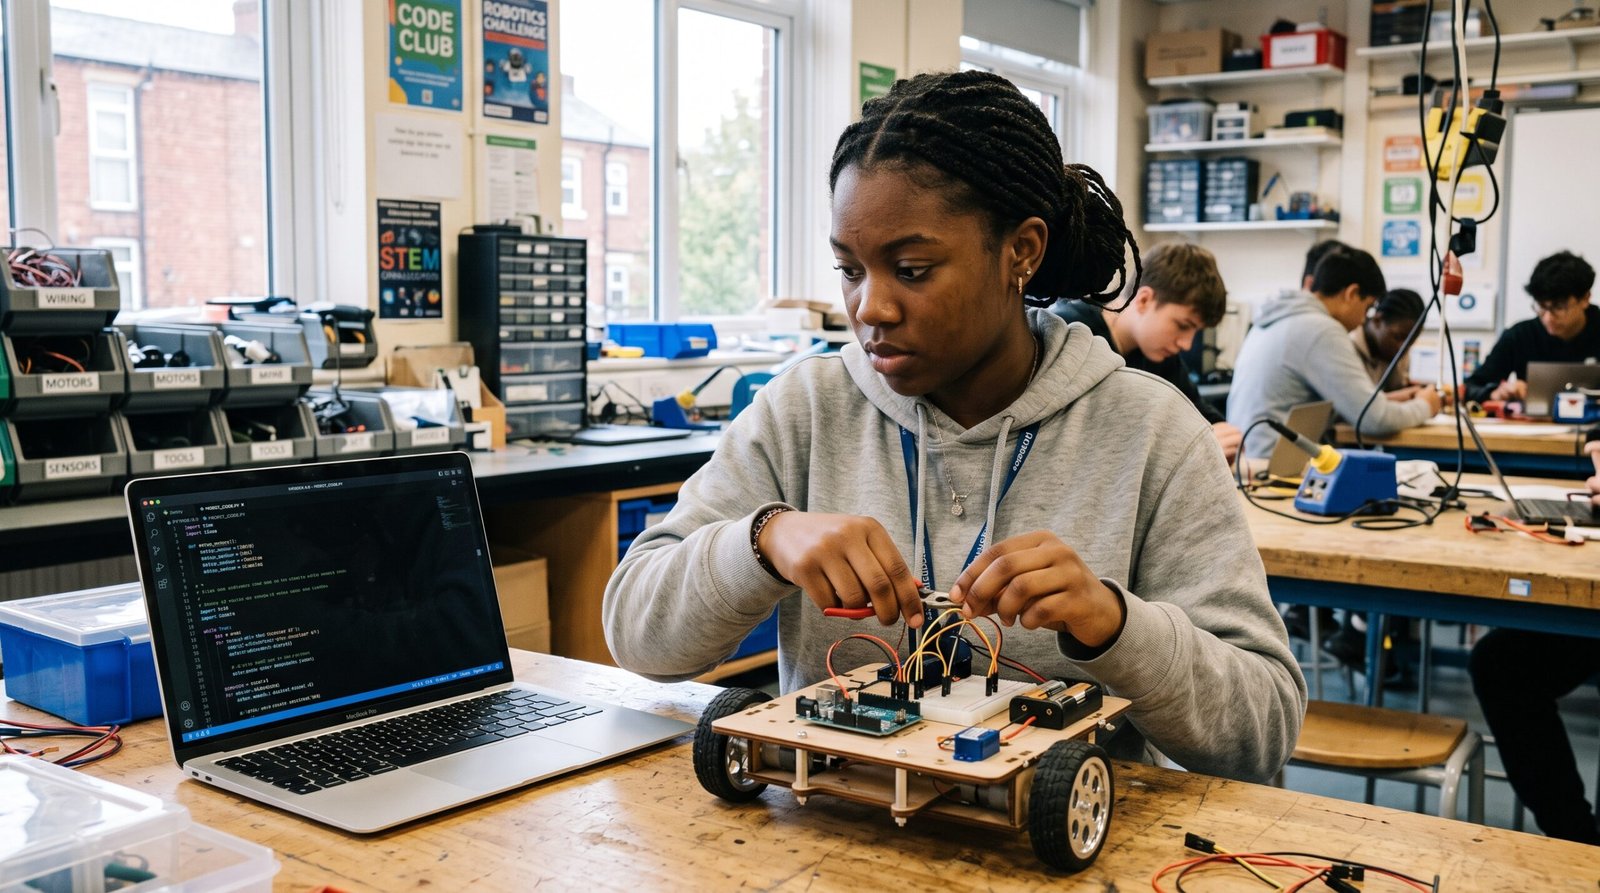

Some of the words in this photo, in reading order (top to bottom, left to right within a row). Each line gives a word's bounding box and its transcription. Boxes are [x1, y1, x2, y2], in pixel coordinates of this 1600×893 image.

[398, 3, 454, 33] CODE
[484, 1, 546, 26] ROBOTICS
[484, 17, 546, 40] CHALLENGE
[399, 29, 454, 58] CLUB
[380, 246, 440, 271] STEM
[46, 293, 87, 304] WIRING
[46, 378, 93, 389] MOTORS
[156, 373, 198, 384] MOTORS
[259, 444, 286, 456] TOOLS
[163, 453, 195, 465] TOOLS
[49, 462, 98, 474] SENSORS
[345, 711, 368, 720] MacBook
